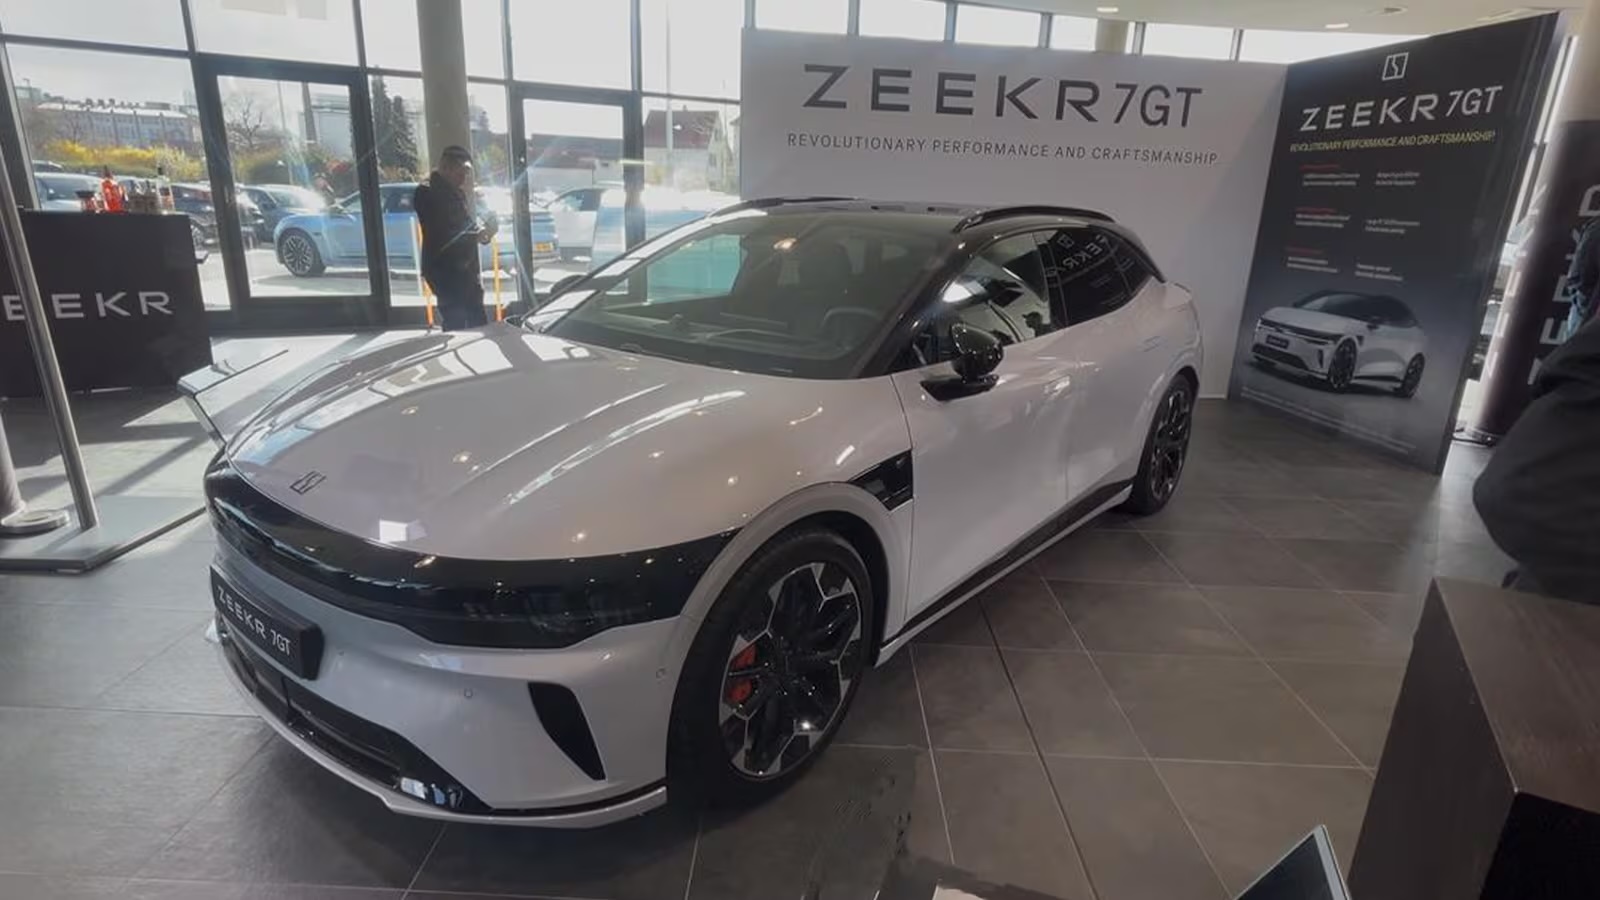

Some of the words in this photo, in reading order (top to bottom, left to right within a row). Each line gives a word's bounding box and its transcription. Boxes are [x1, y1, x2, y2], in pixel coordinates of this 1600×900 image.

[802, 63, 1100, 122] ZEEKR
[1113, 82, 1203, 128] 7GT
[1299, 93, 1440, 131] ZEEKR
[1445, 86, 1503, 117] 7GT
[788, 132, 926, 152] REVOLUTIONARY
[932, 138, 1049, 158] PERFORMANCE
[1055, 146, 1086, 160] AND
[1091, 147, 1218, 165] CRAFTSMANSHIP
[1397, 134, 1415, 146] AND
[2, 291, 173, 321] EEKR
[216, 584, 267, 640] ZEEKR
[270, 627, 291, 656] 7GT
